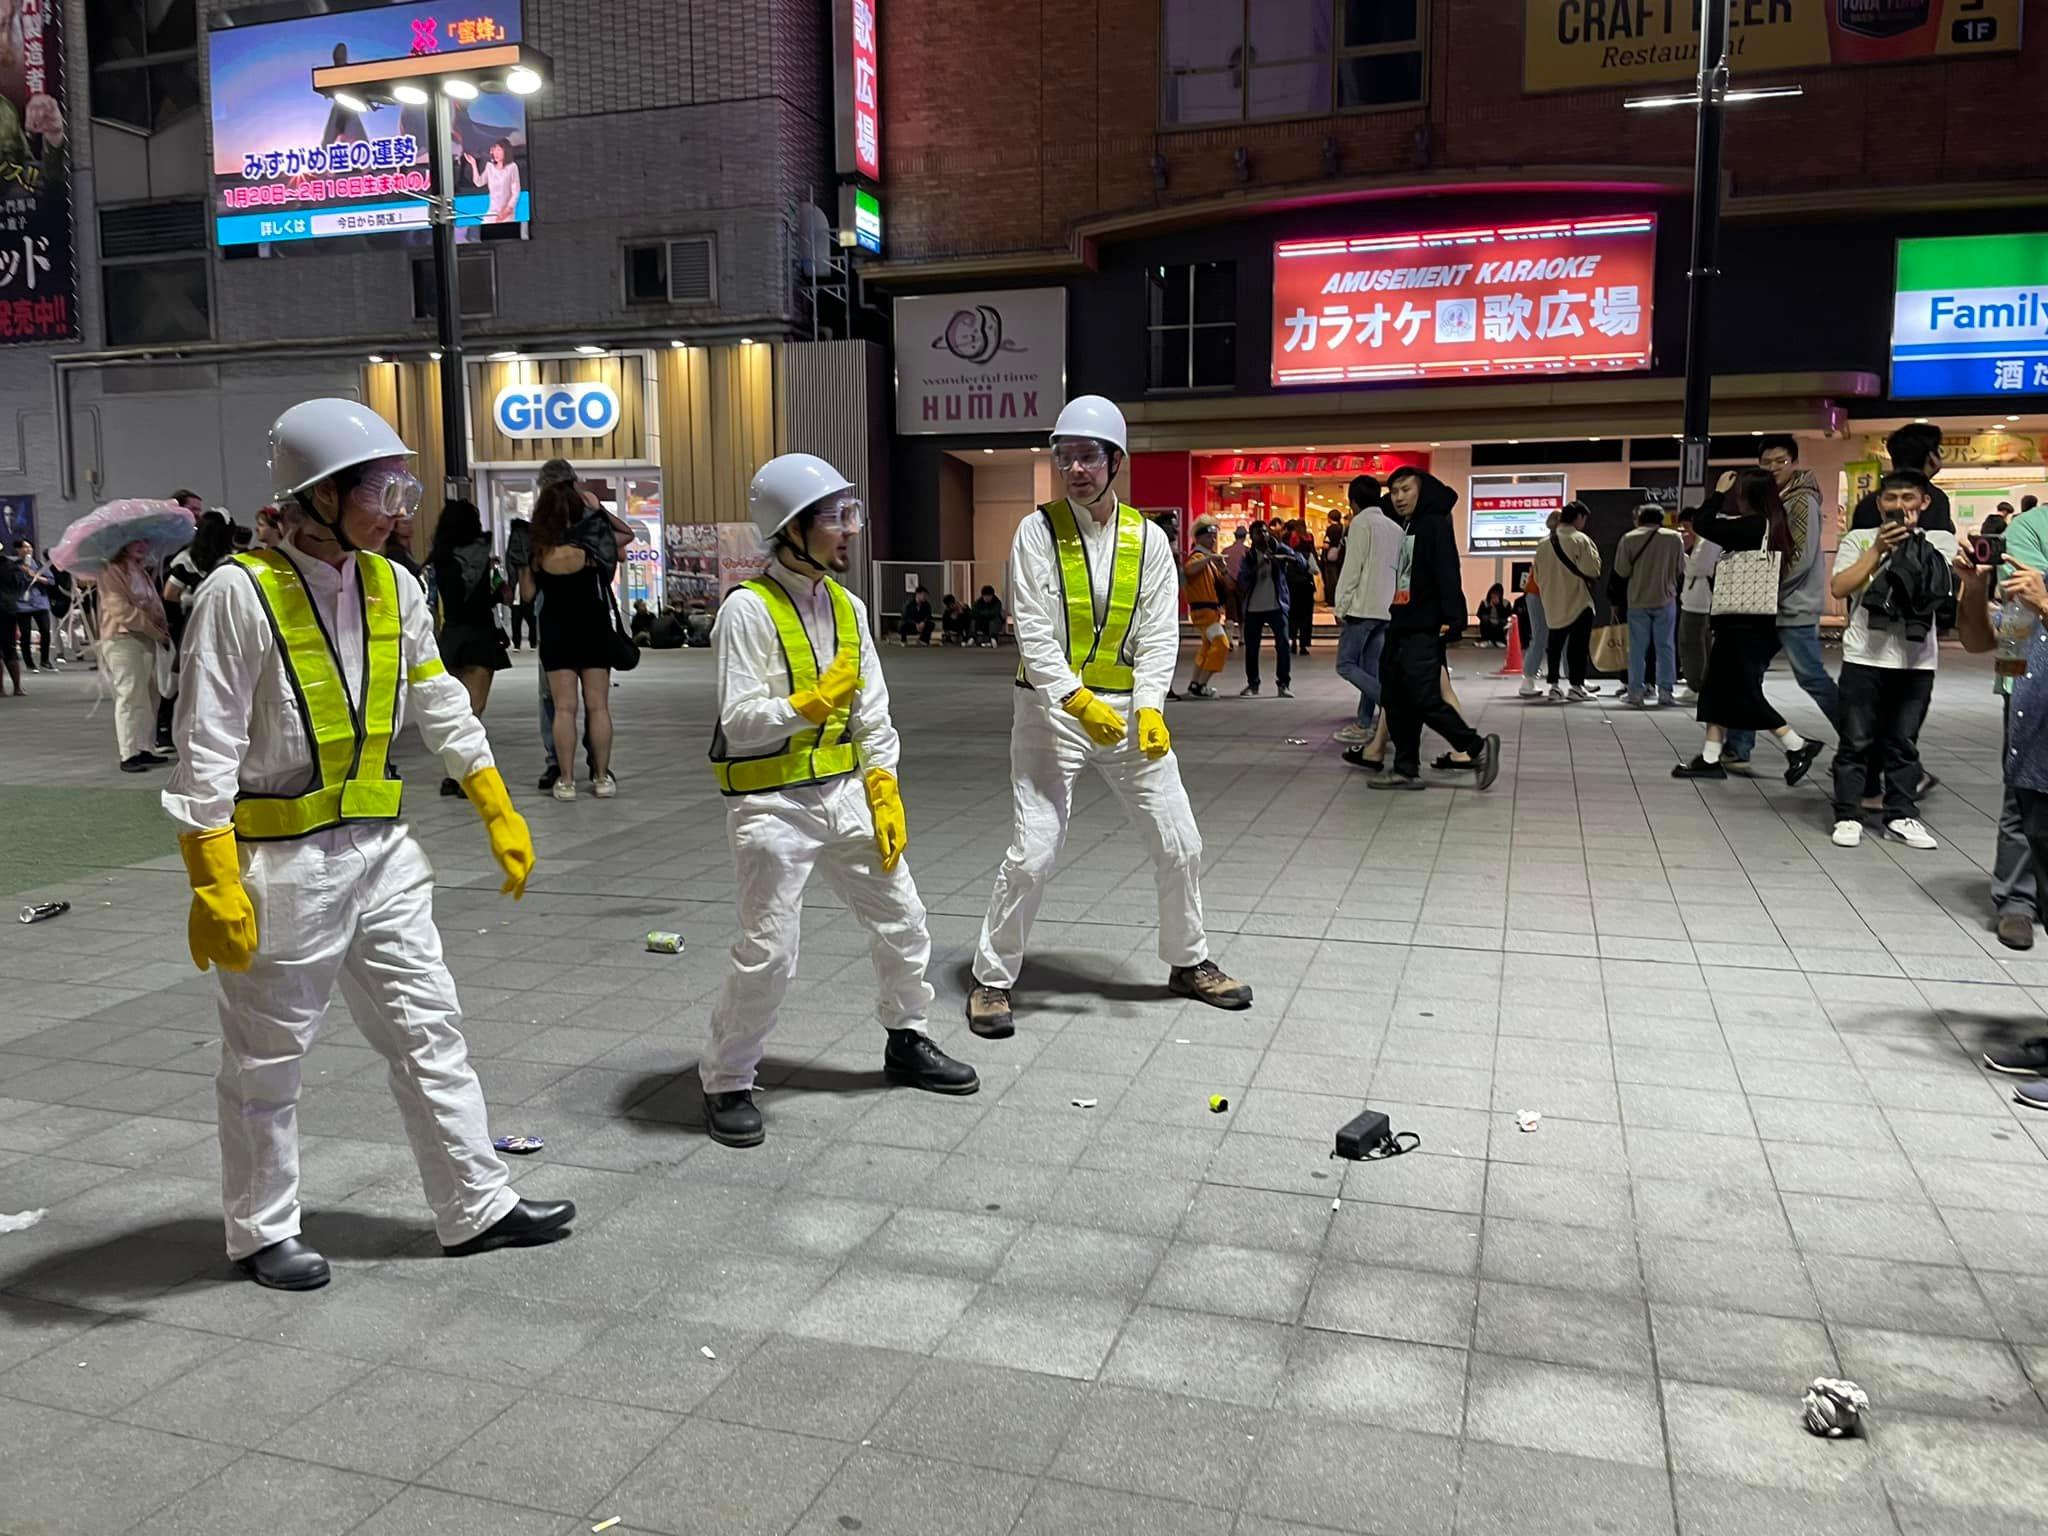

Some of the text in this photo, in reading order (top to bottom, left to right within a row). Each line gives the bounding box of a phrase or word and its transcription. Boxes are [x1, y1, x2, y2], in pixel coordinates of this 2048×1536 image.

[1963, 20, 1990, 41] 1F
[853, 0, 876, 165] 歌広場
[242, 134, 416, 180] みずがめ座の運勢
[260, 218, 306, 237] 詳しくは
[1321, 254, 1602, 295] AMUSEMENT KARAOKE
[1283, 285, 1642, 353] カラオケ 歌広場
[922, 371, 1039, 387] wonderful time
[501, 391, 613, 431] GiGO
[627, 550, 660, 561] GiGO
